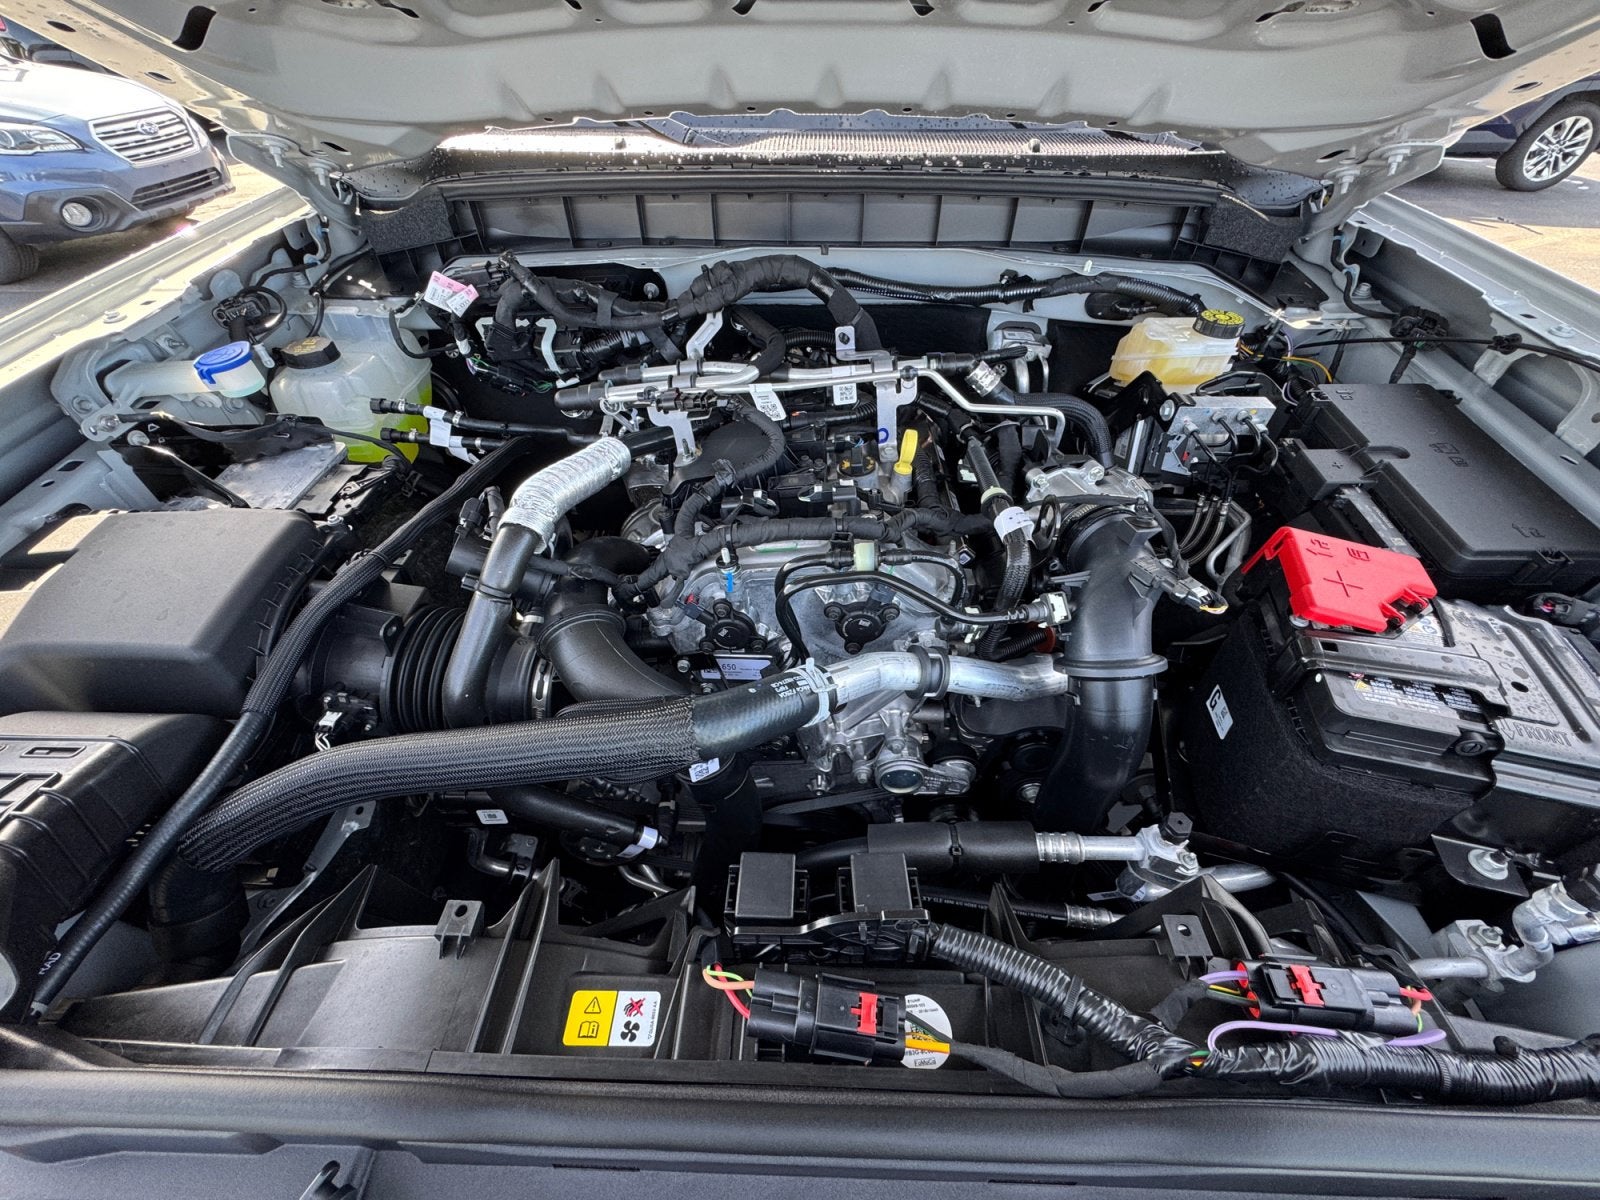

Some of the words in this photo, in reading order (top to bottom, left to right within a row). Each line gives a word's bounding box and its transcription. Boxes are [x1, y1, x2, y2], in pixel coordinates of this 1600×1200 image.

[721, 663, 736, 671] 650
[1209, 688, 1221, 712] G
[1512, 721, 1572, 747] FRONT
